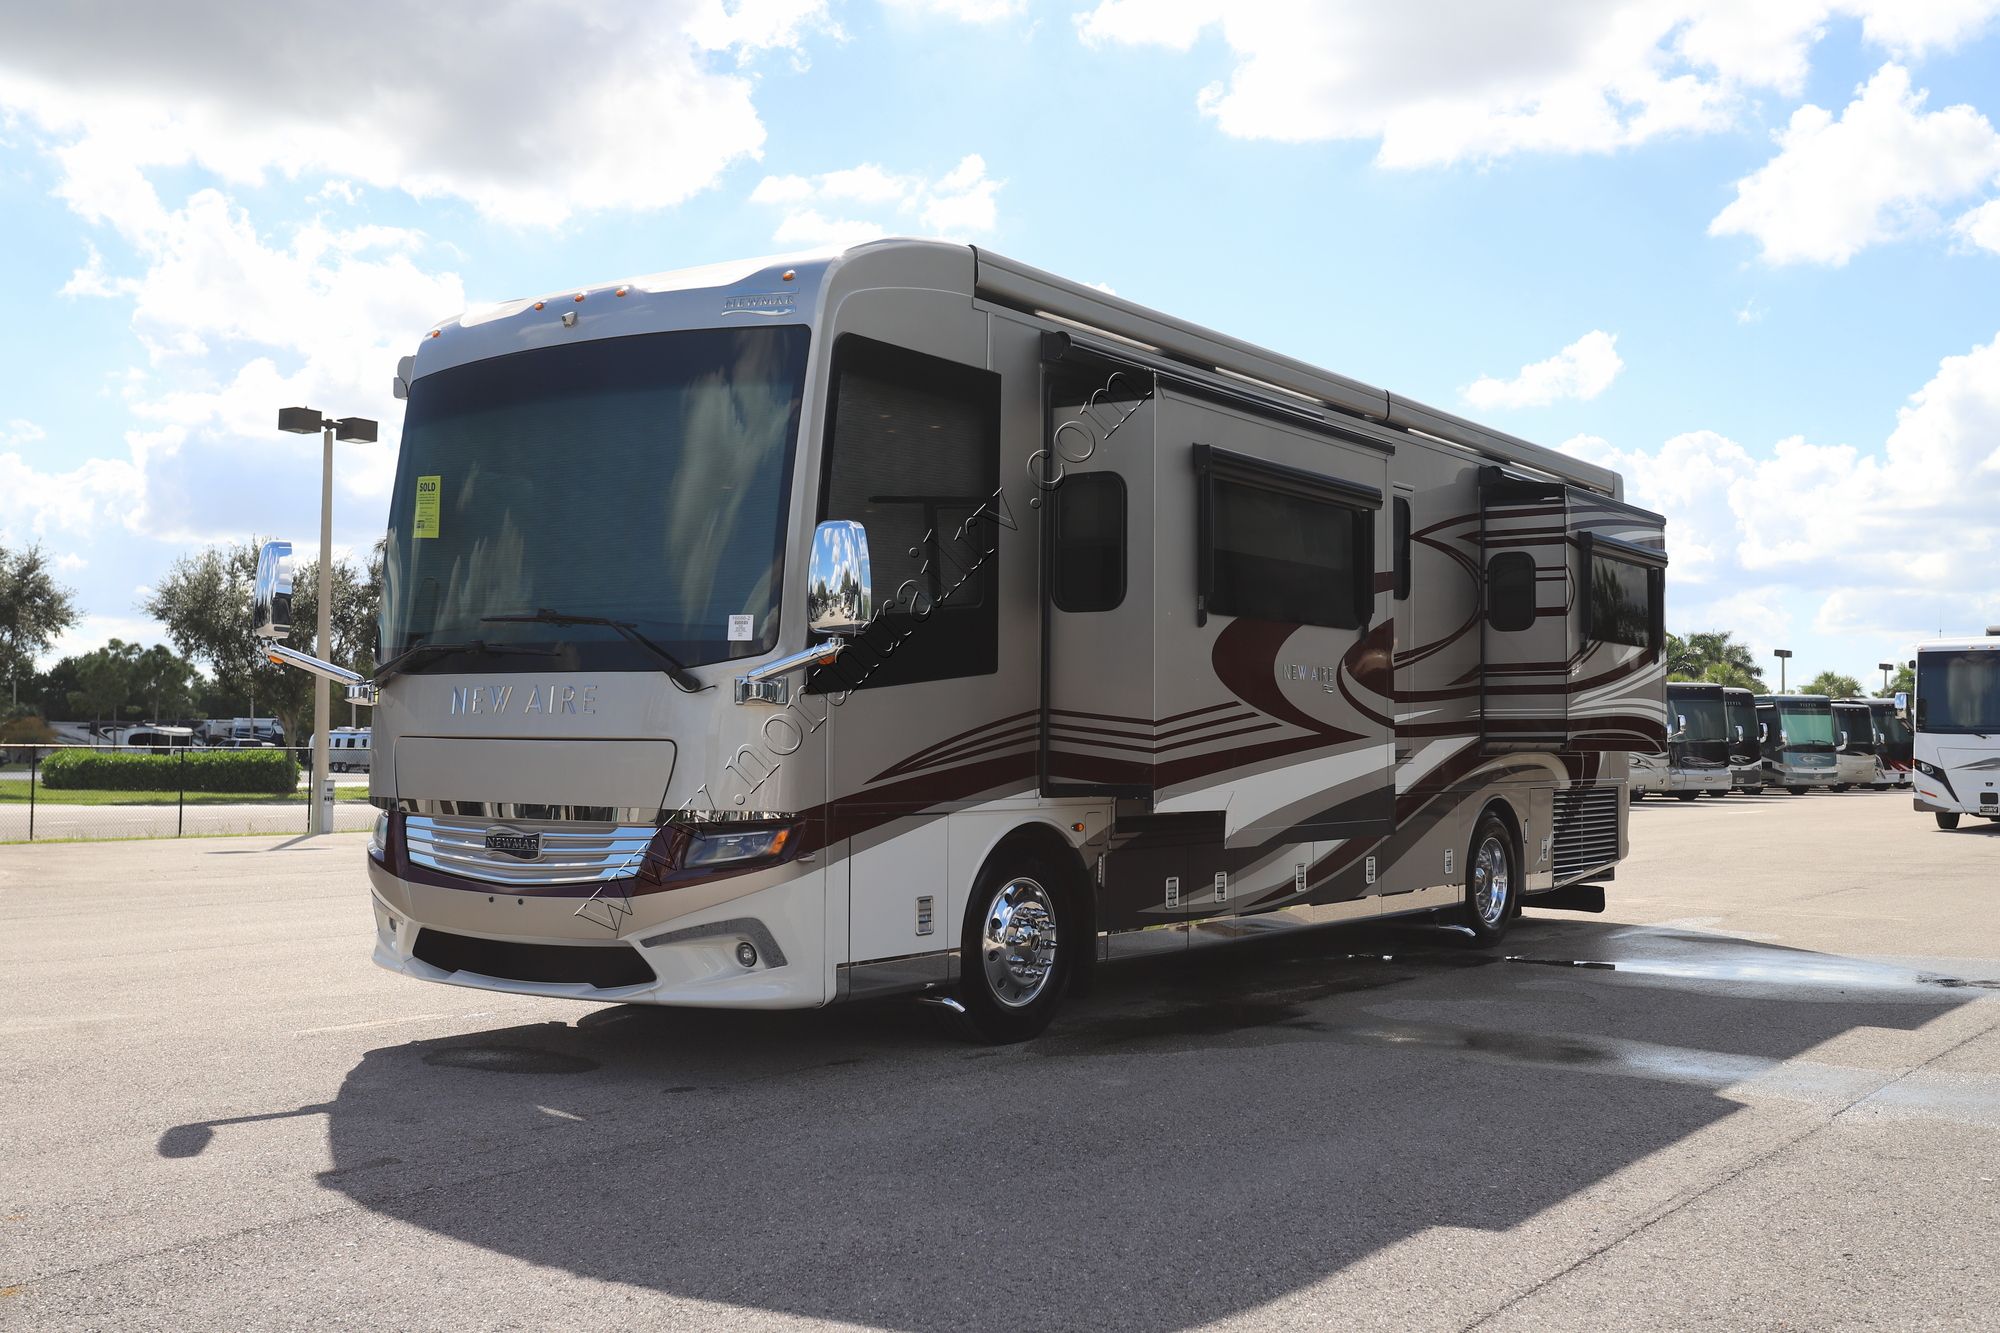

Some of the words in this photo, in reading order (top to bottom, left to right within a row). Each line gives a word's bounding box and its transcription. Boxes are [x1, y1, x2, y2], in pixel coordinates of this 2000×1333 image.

[420, 482, 436, 492] SOLD
[1283, 664, 1307, 680] NEW
[1311, 666, 1333, 682] AIRE
[451, 686, 513, 715] NEW
[525, 684, 598, 715] AIRE
[487, 837, 539, 850] NEWMAR
